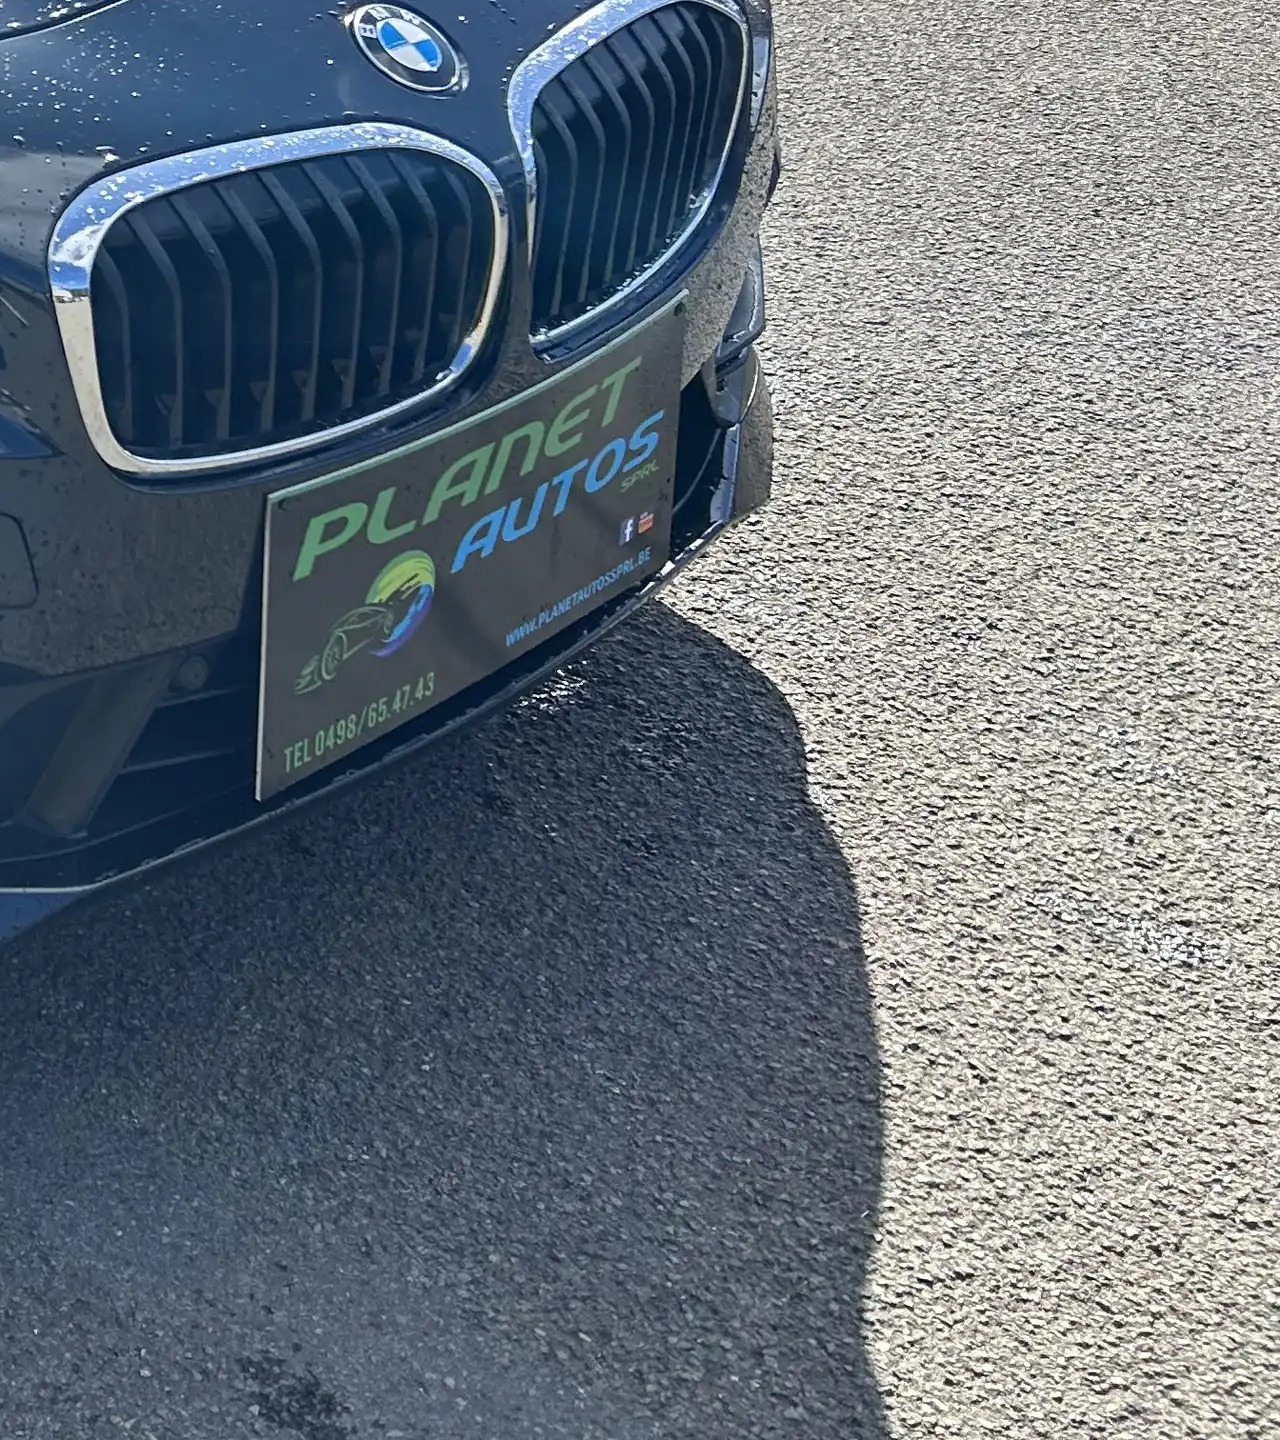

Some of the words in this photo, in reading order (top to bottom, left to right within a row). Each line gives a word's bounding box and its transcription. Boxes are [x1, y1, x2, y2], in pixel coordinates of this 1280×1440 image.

[291, 356, 643, 582] PLANET
[450, 410, 666, 574] AUTOS
[620, 458, 660, 495] SPRL
[505, 546, 652, 647] WWW.PLANETAUTOSSPRL.BE
[284, 738, 312, 773] TEL
[315, 672, 435, 756] 0498/65.47.43
